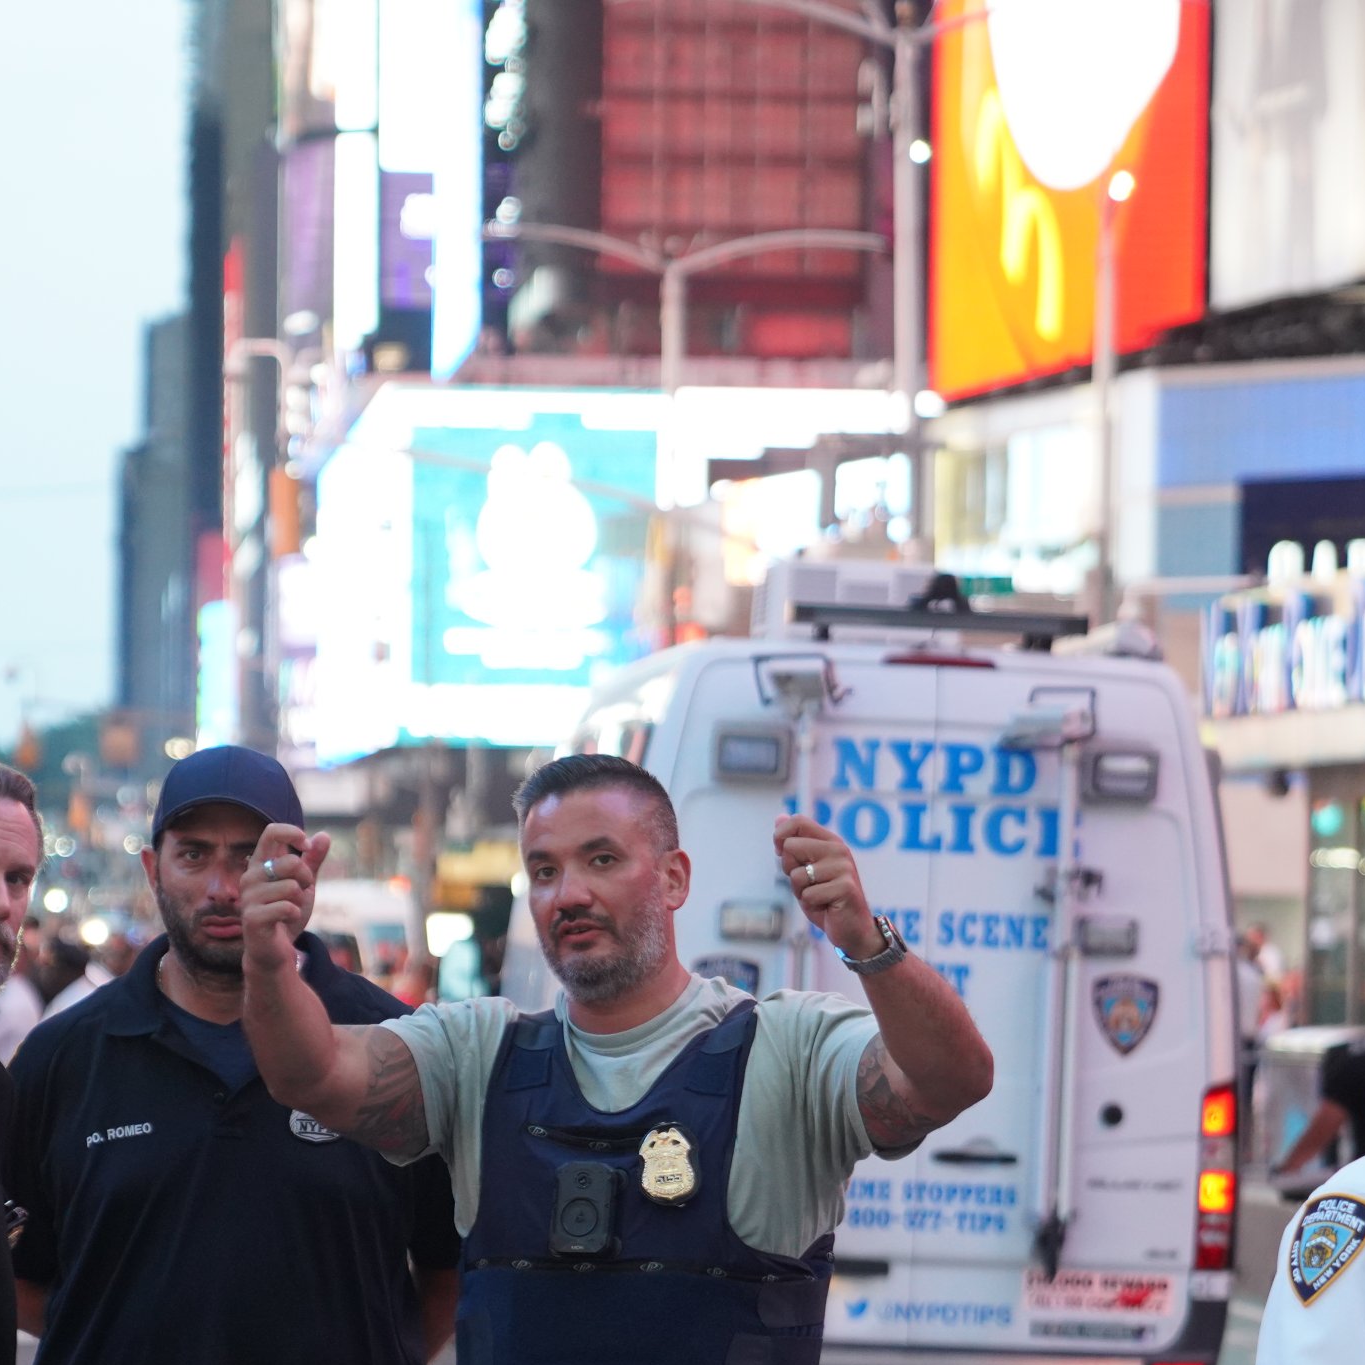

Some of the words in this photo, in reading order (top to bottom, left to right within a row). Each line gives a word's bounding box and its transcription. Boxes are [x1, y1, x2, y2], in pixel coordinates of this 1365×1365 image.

[832, 738, 1037, 796] NYPD
[784, 796, 1082, 858] OLICE
[937, 911, 1049, 950] SCENE
[107, 1122, 152, 1140] ROMEO
[845, 1179, 891, 1199] IME
[903, 1180, 1017, 1206] STOPPERS
[1317, 1198, 1358, 1214] POLICE
[1302, 1209, 1365, 1232] DEPARTMENT
[1291, 1240, 1300, 1266] CITY
[1312, 1268, 1334, 1291] NEW
[1332, 1237, 1361, 1268] YORK
